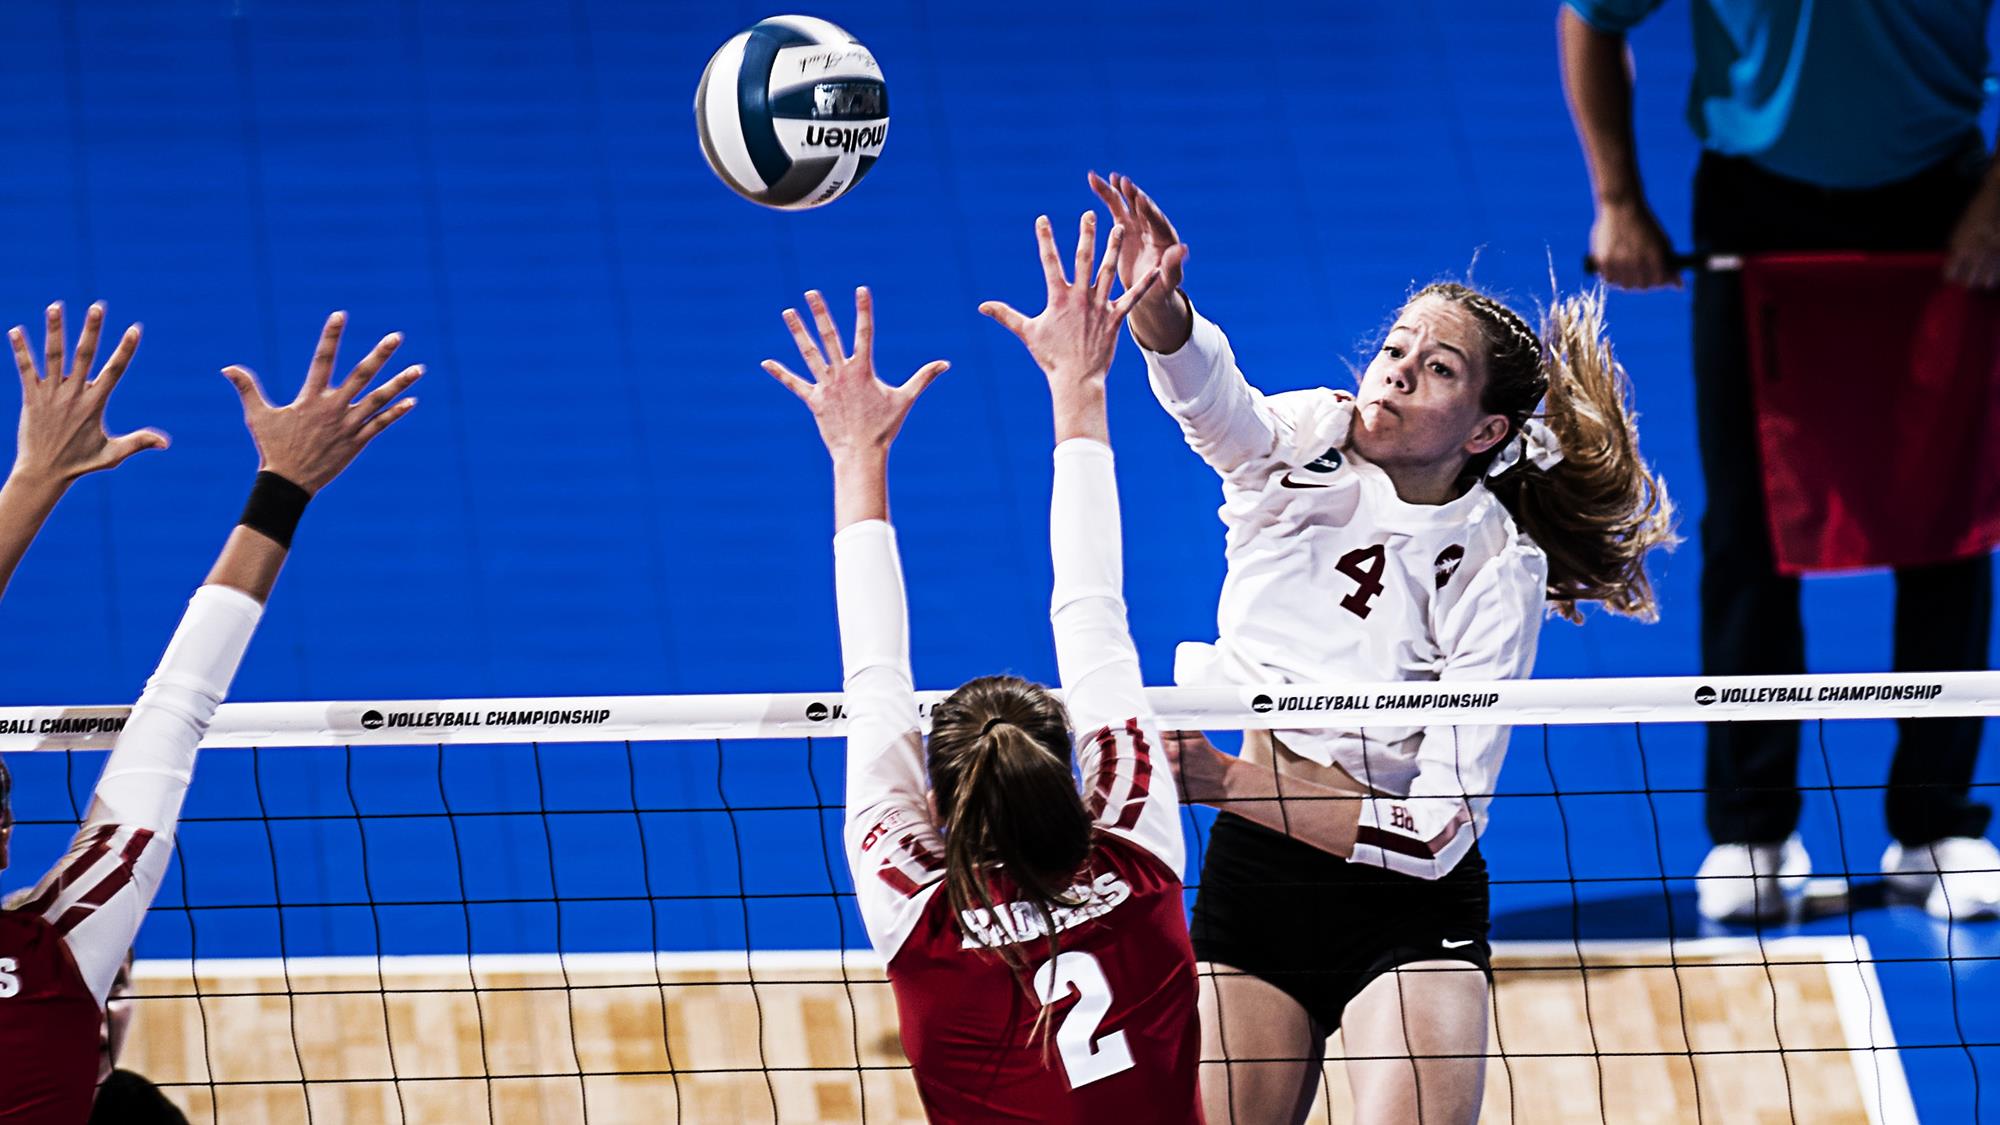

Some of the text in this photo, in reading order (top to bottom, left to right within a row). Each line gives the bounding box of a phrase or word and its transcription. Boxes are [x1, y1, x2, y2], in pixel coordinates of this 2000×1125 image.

[806, 124, 886, 153] molten
[1334, 544, 1386, 620] 4
[1278, 693, 1500, 711] VOLLEYBALL CHAMPIONSHIP
[1720, 684, 1942, 703] VOLLEYBALL CHAMPIONSHIP
[0, 719, 36, 734] BALL
[387, 710, 610, 728] VOLLEYBALL CHAMPIONSHIP
[961, 871, 1132, 949] BADRS
[1033, 950, 1137, 1090] 2
